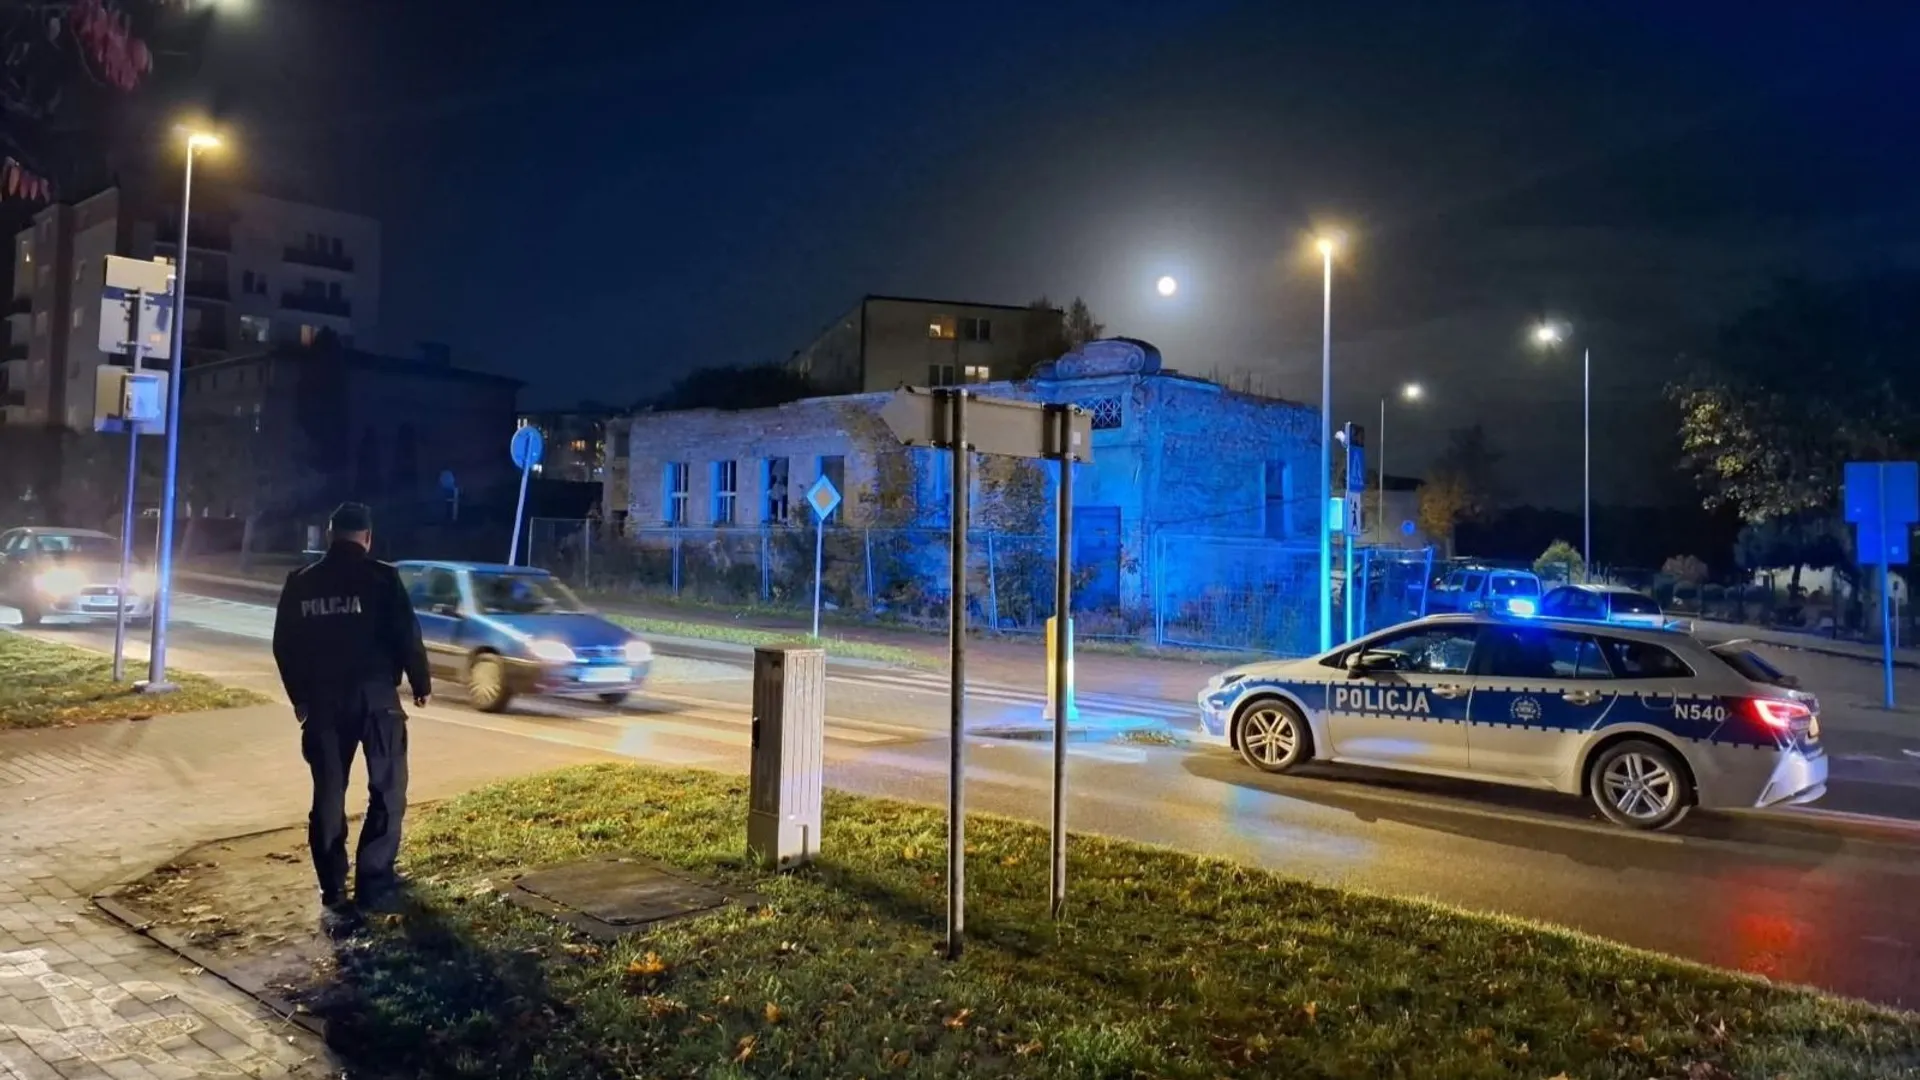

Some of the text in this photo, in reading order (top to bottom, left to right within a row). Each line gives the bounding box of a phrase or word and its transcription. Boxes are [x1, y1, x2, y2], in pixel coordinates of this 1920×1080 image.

[301, 596, 361, 617] POLICJA
[1335, 687, 1430, 713] POLICJA
[1675, 704, 1725, 721] N540
